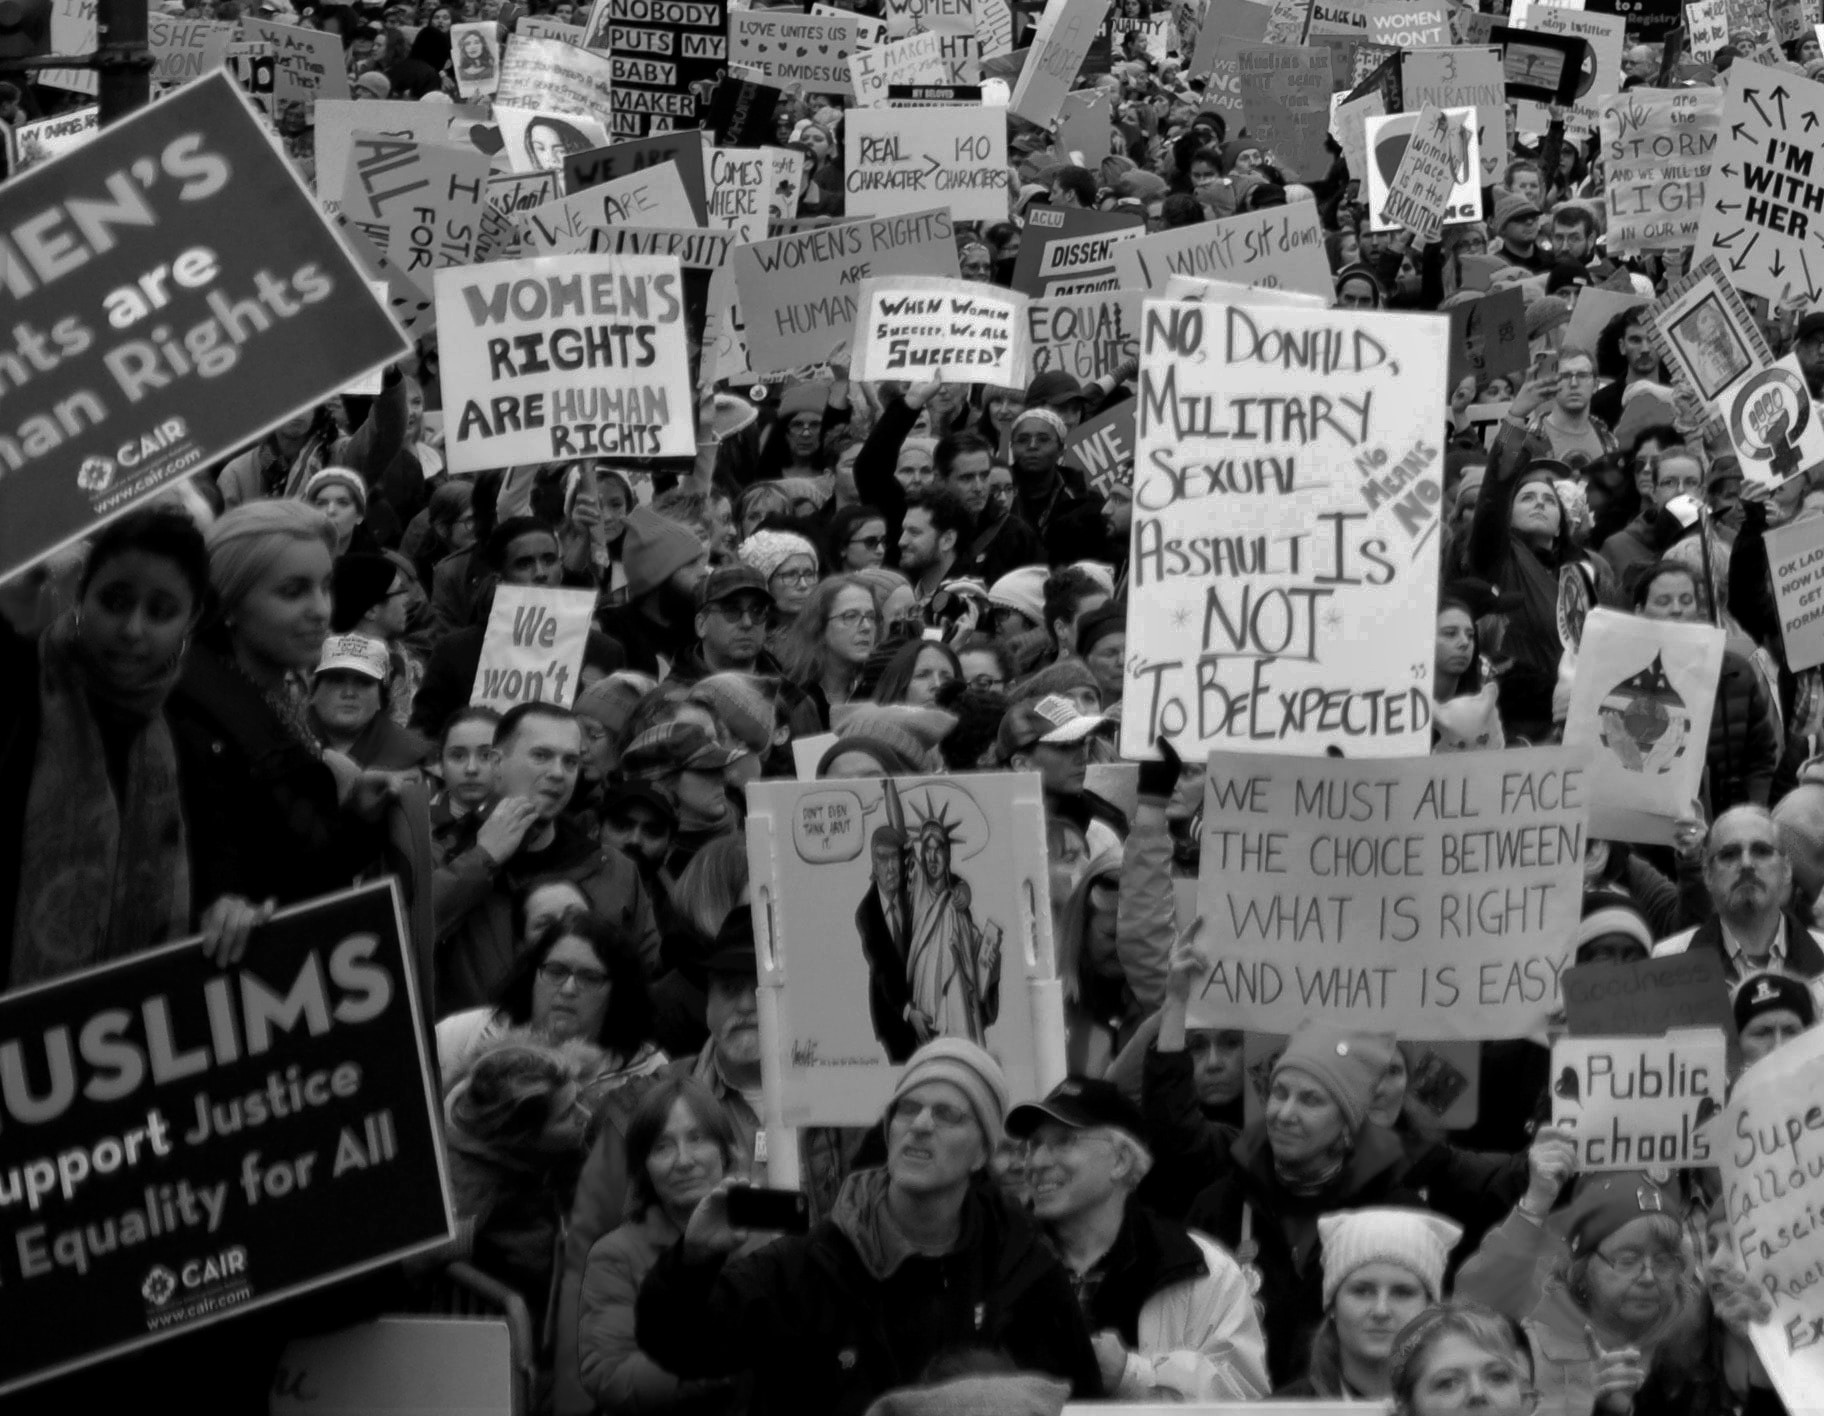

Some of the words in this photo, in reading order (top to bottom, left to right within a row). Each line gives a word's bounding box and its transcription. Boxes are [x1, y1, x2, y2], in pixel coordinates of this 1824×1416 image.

[611, 28, 672, 53] PUTS
[685, 34, 725, 56] MY
[611, 60, 675, 82] BABY
[611, 89, 694, 115] MAKER
[859, 137, 909, 163] REAL
[954, 136, 990, 161] 140
[1765, 138, 1815, 176] I'M
[847, 167, 927, 193] CHARACTER
[935, 167, 1008, 192] CHARACTERS
[1744, 196, 1810, 238] HER
[103, 246, 220, 329] are
[464, 272, 681, 329] WOMEN'S
[104, 262, 334, 402] Rights
[488, 325, 658, 382] RIGHTS
[1225, 305, 1401, 378] DONALD,
[456, 389, 545, 442] ARE
[551, 386, 670, 426] HUMAN
[1140, 364, 1375, 443] MILITARY
[117, 416, 187, 467] CAIR
[549, 423, 662, 456] RIGHTS
[1135, 449, 1298, 511] SEXUAL
[1134, 518, 1309, 586] ASSAULT
[1315, 511, 1398, 586] IS
[1778, 562, 1797, 577] OK
[1782, 573, 1811, 596] NOW
[1799, 587, 1822, 606] GET
[512, 606, 558, 649] We
[1201, 586, 1335, 660] NOT
[483, 664, 569, 703] won't
[1211, 776, 1270, 816] WE
[1294, 778, 1400, 823] MUST
[1412, 778, 1480, 821] ALL
[1500, 768, 1584, 813] FACE
[1211, 830, 1289, 874] THE
[1309, 833, 1425, 878] CHOICE
[1442, 822, 1582, 876] BETWEEN
[1228, 894, 1352, 942] WHAT
[1380, 896, 1420, 940] IS
[1441, 884, 1556, 936] RIGHT
[1201, 959, 1283, 1005] AND
[1295, 968, 1398, 1009] WHAT
[1421, 966, 1460, 1008] IS
[1478, 953, 1569, 1005] EASY
[1586, 1054, 1709, 1098] Public
[185, 1061, 363, 1145] Justice
[15, 1179, 228, 1279] Equality
[240, 1151, 319, 1205] for
[332, 1109, 398, 1178] All
[181, 1244, 247, 1287] CAIR
